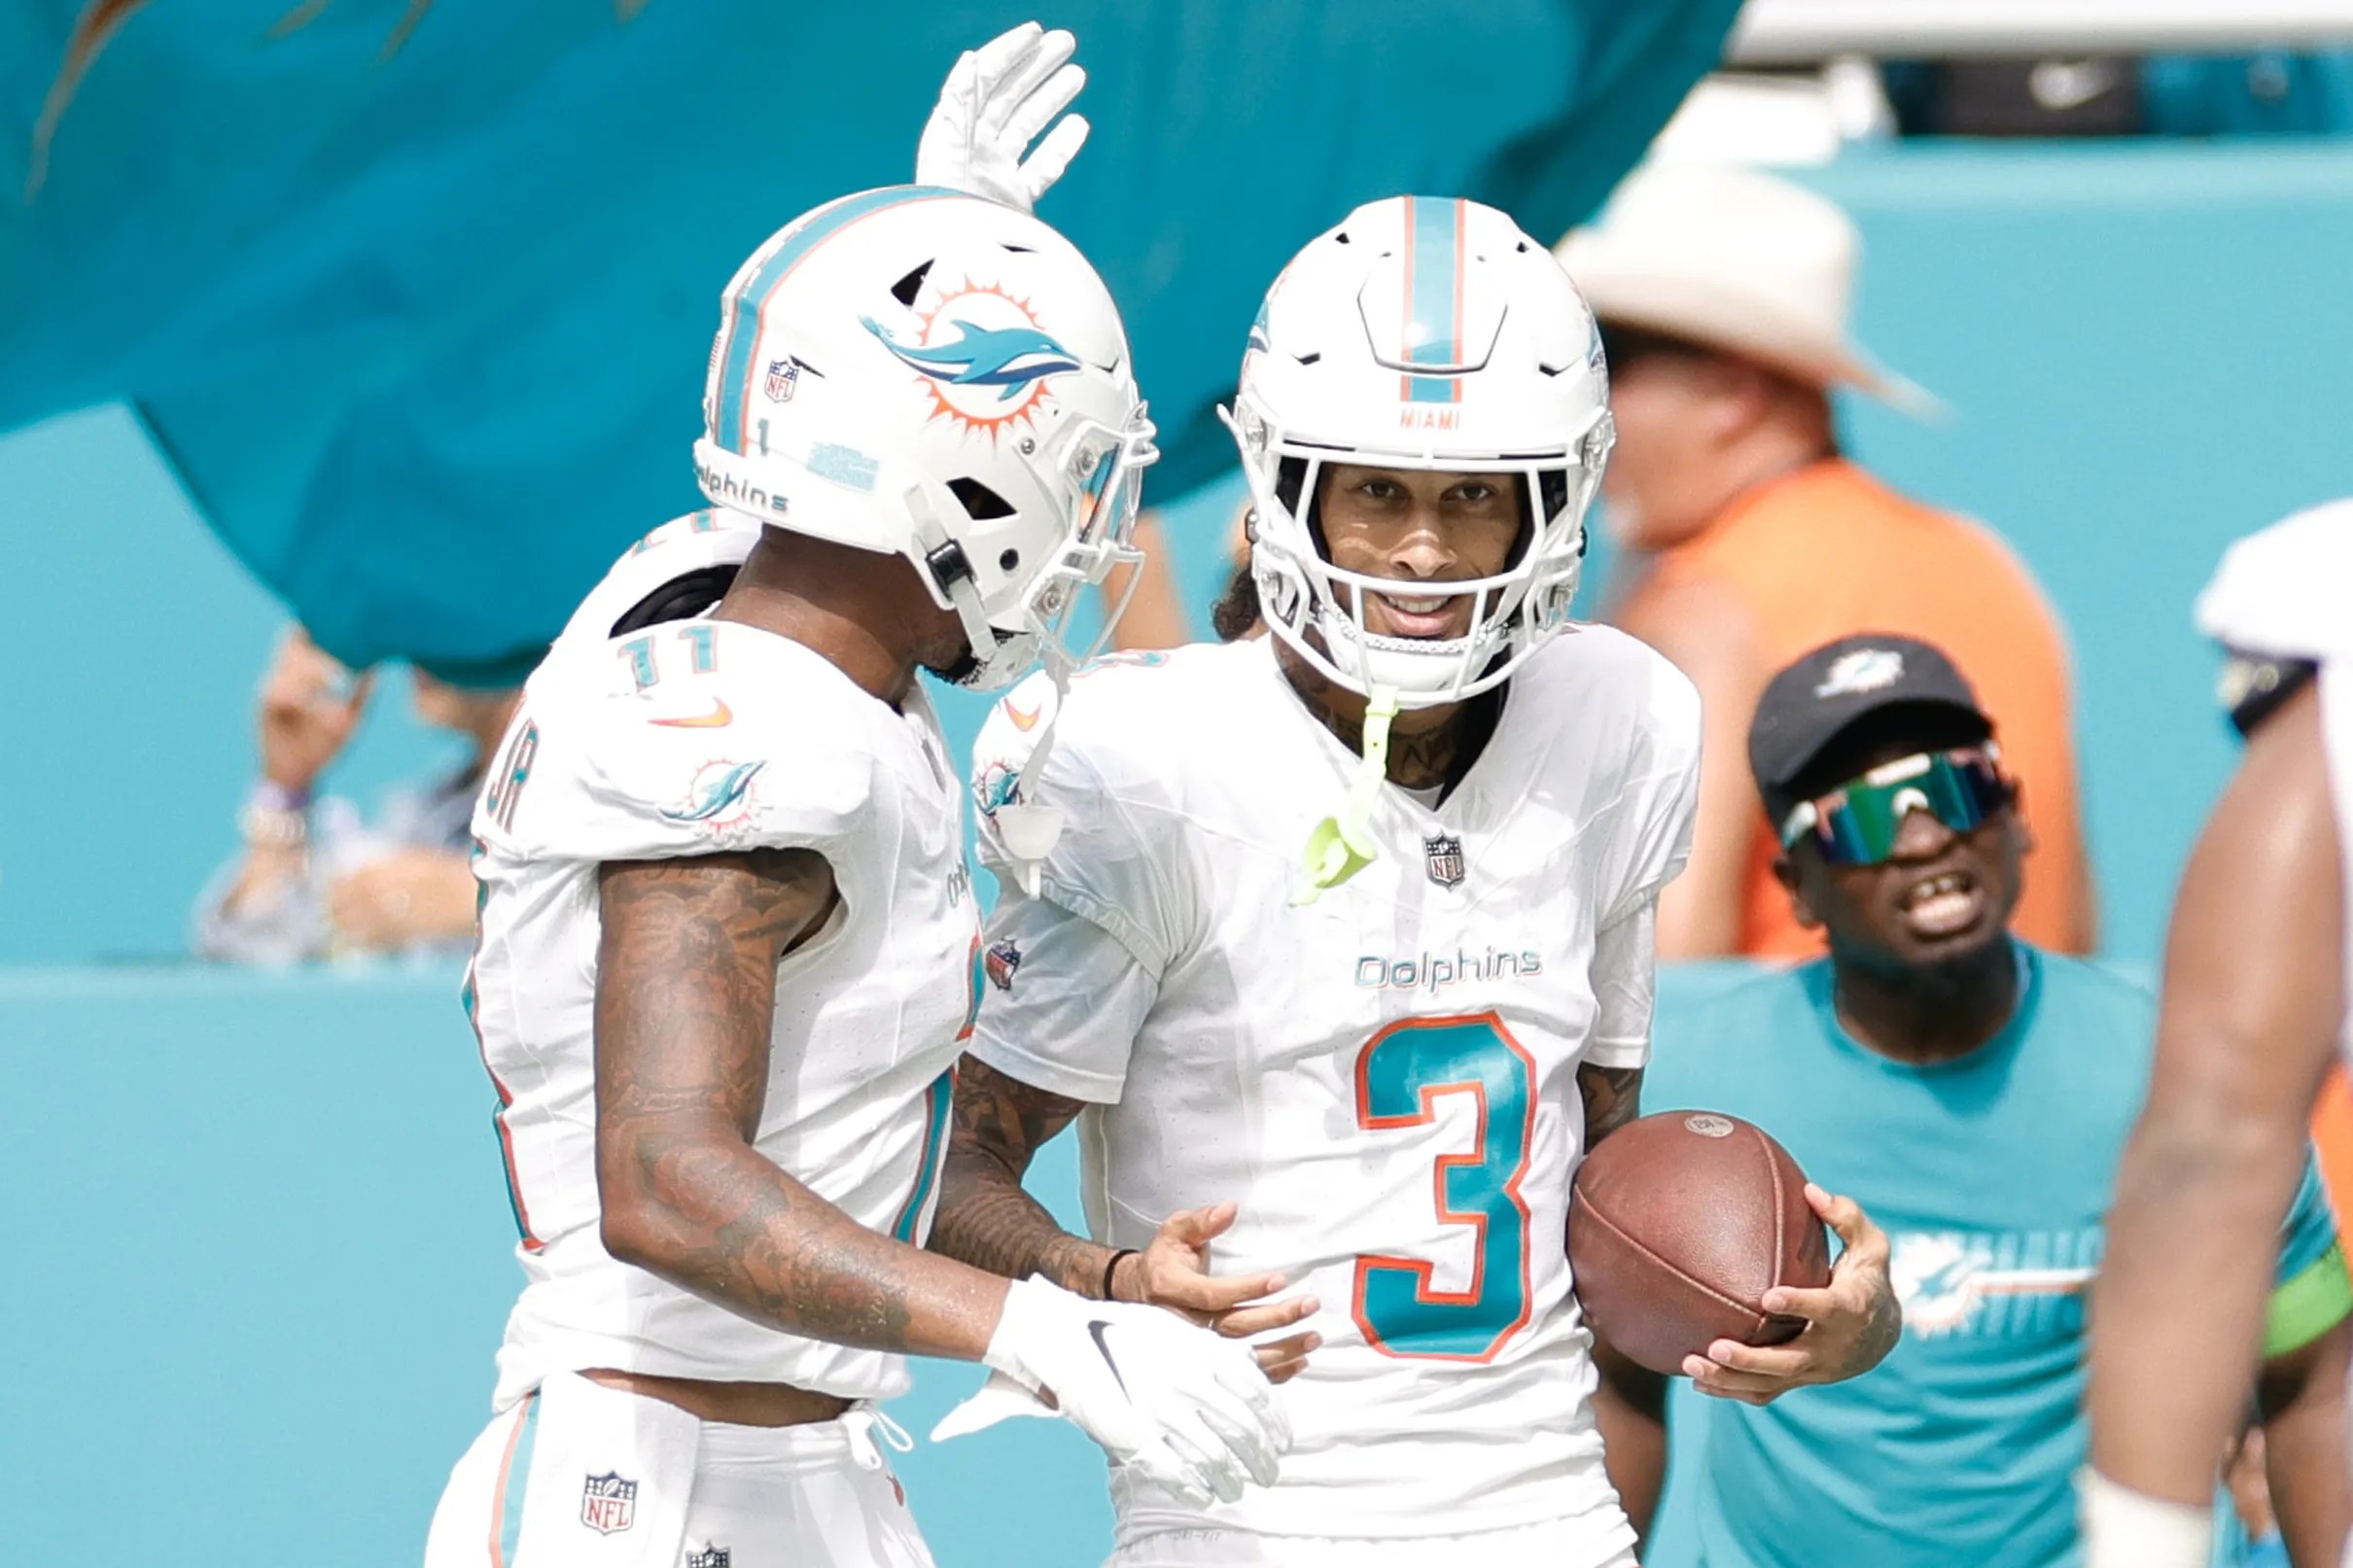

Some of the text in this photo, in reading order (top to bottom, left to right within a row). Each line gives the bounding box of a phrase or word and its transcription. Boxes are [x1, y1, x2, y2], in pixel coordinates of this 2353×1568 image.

[767, 374, 791, 399] NFL
[1399, 407, 1460, 431] MIAMI
[616, 624, 720, 694] 11
[1432, 855, 1461, 879] NFL
[1354, 945, 1542, 995] Dolphins
[1351, 1010, 1536, 1364] 3
[586, 1497, 630, 1529] NFL
